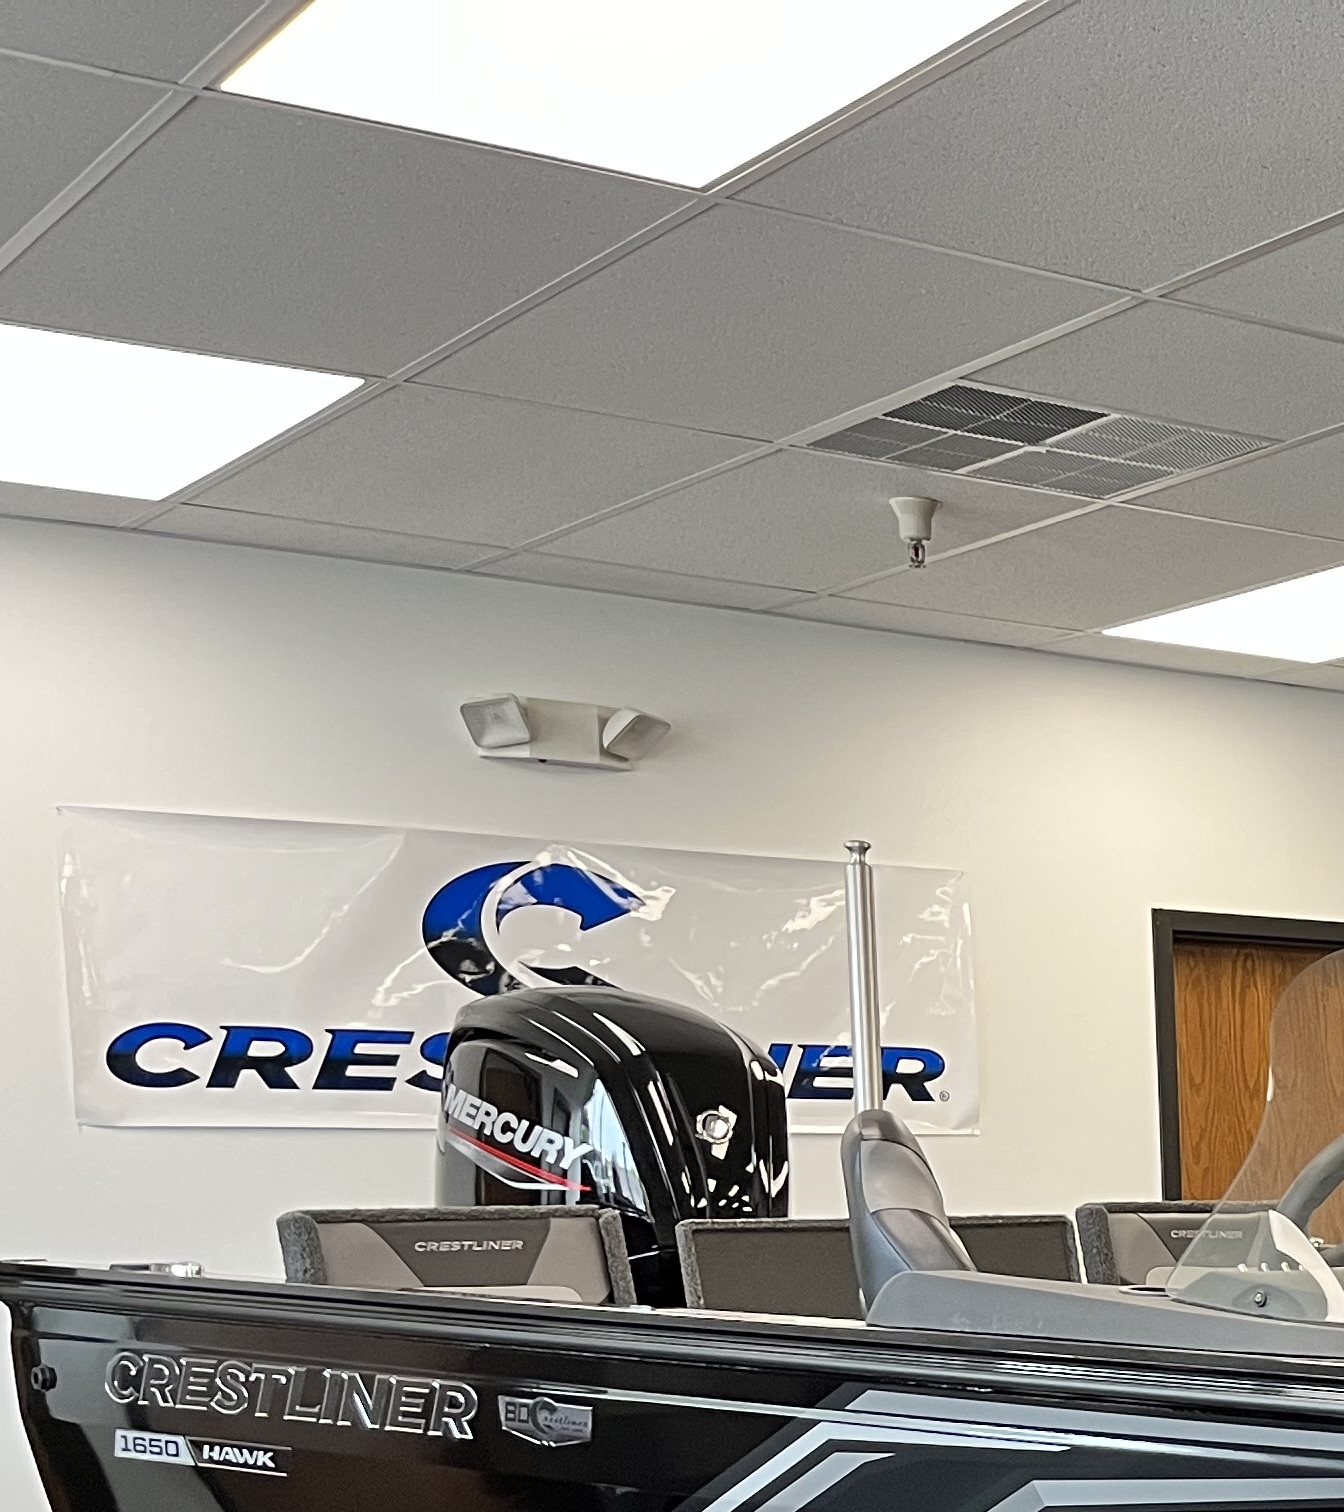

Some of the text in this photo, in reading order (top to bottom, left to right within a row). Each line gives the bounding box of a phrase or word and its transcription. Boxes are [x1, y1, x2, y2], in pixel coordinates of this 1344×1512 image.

[444, 1084, 593, 1170] MERCURY
[414, 1239, 524, 1252] CRESTLINER
[105, 1351, 478, 1440] CRESTLINER
[121, 1435, 276, 1469] 1650 HAWK
